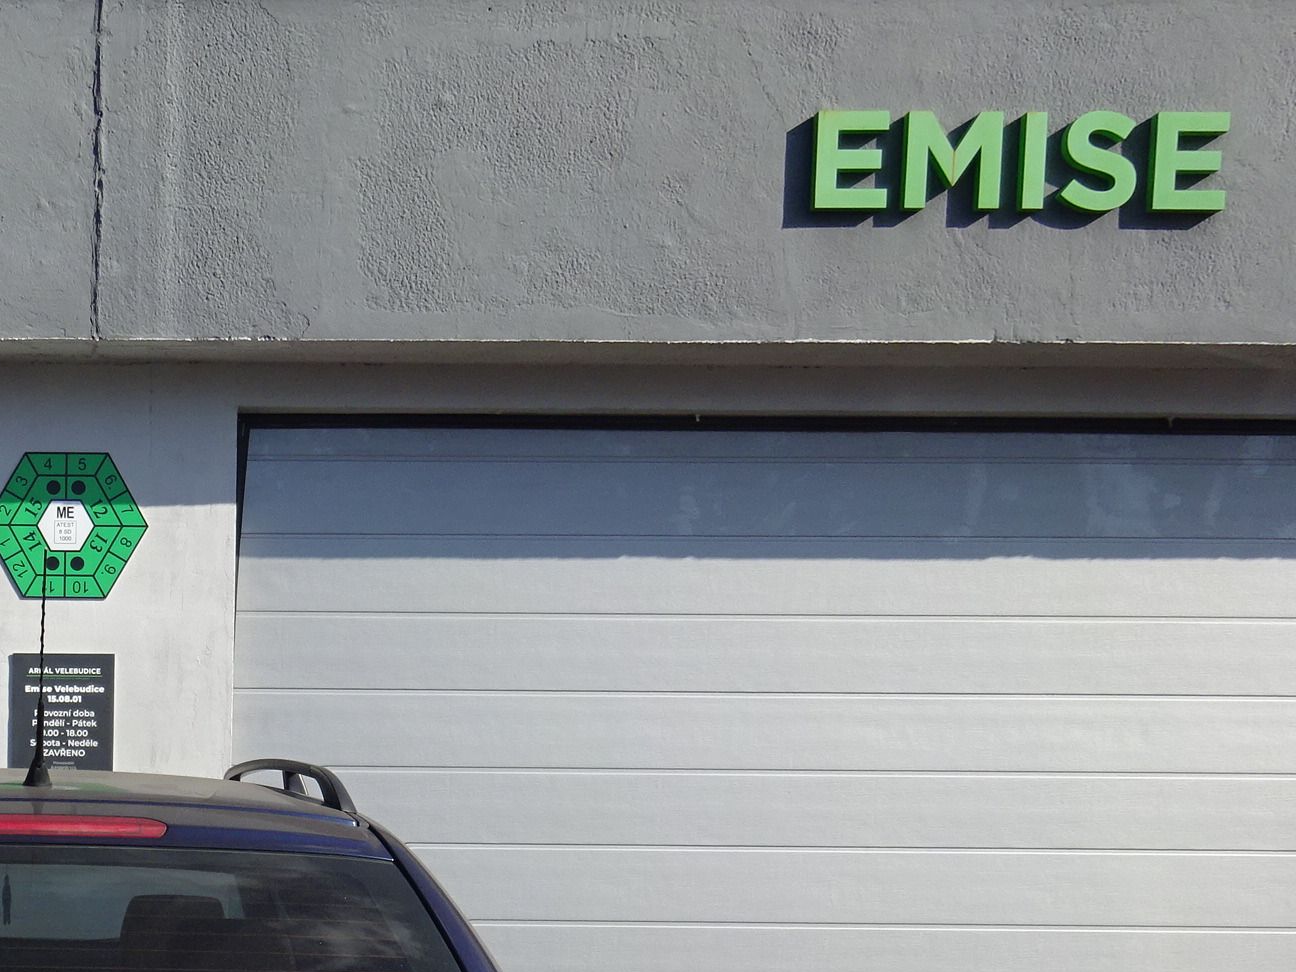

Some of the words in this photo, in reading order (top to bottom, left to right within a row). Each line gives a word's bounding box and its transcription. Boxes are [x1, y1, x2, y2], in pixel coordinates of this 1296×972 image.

[811, 110, 1231, 213] EMISE
[44, 458, 53, 470] 4
[78, 458, 87, 471] 5
[15, 475, 28, 487] 3
[0, 504, 12, 516] 2
[25, 497, 43, 518] 15
[56, 506, 75, 519] ME
[89, 499, 108, 519] 12
[121, 505, 134, 515] 7
[0, 537, 11, 546] 1
[23, 531, 42, 551] 14
[90, 534, 108, 552] 13
[120, 537, 132, 548] 8
[12, 560, 29, 578] 12
[72, 581, 89, 593] 10
[55, 667, 101, 675] VELEBUDICE
[54, 684, 105, 693] Velebudice
[47, 695, 82, 703] 15.08.01
[34, 709, 71, 717] Povozní
[73, 709, 95, 717] doba
[32, 719, 65, 727] Pndělí
[72, 719, 97, 727] Pátek
[66, 729, 89, 737] 18.00
[67, 739, 98, 747] Neděle
[43, 748, 86, 757] ZAVŘENO
